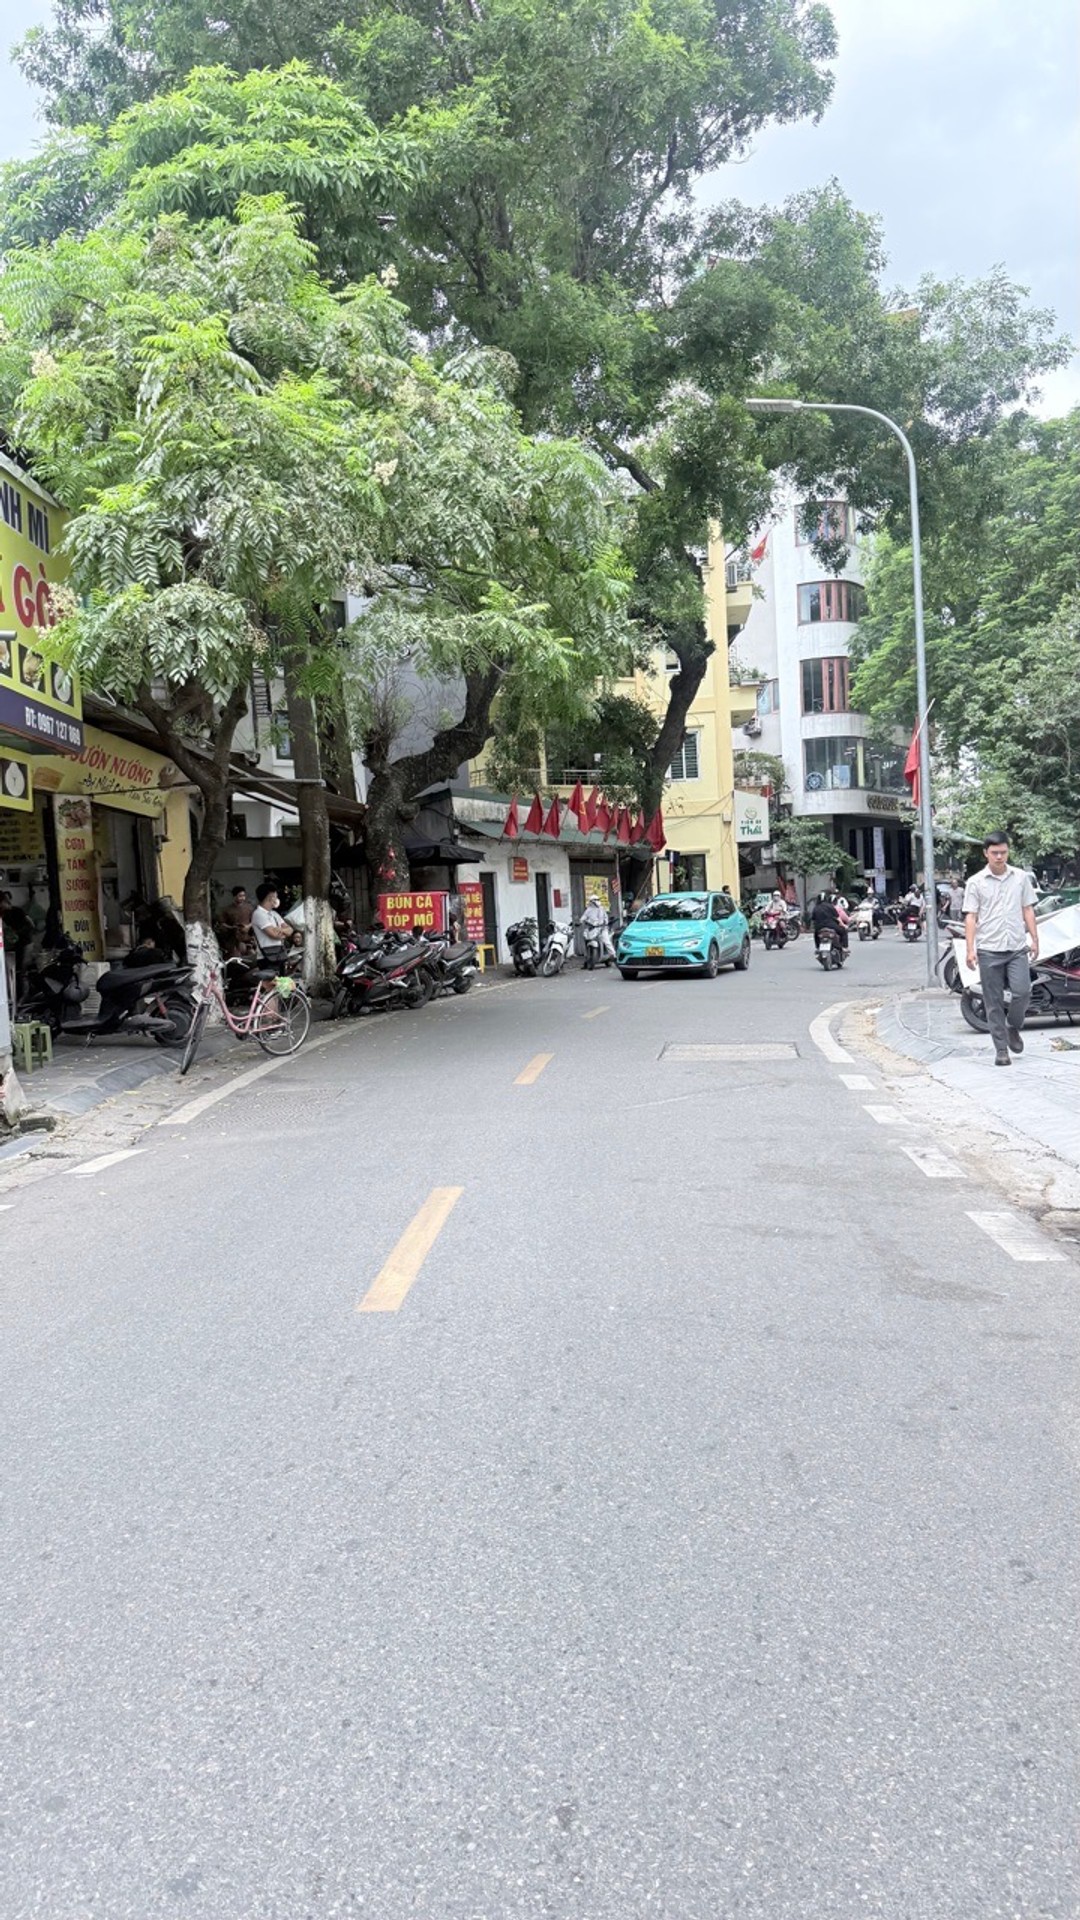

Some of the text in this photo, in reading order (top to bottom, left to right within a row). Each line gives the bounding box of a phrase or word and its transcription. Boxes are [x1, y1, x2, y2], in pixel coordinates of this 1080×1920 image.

[56, 720, 67, 740] 127
[109, 757, 153, 785] NƯỚNG
[65, 838, 85, 850] CƠM
[387, 894, 433, 909] BÚN CÁ
[386, 911, 434, 927] TÓP MỠ
